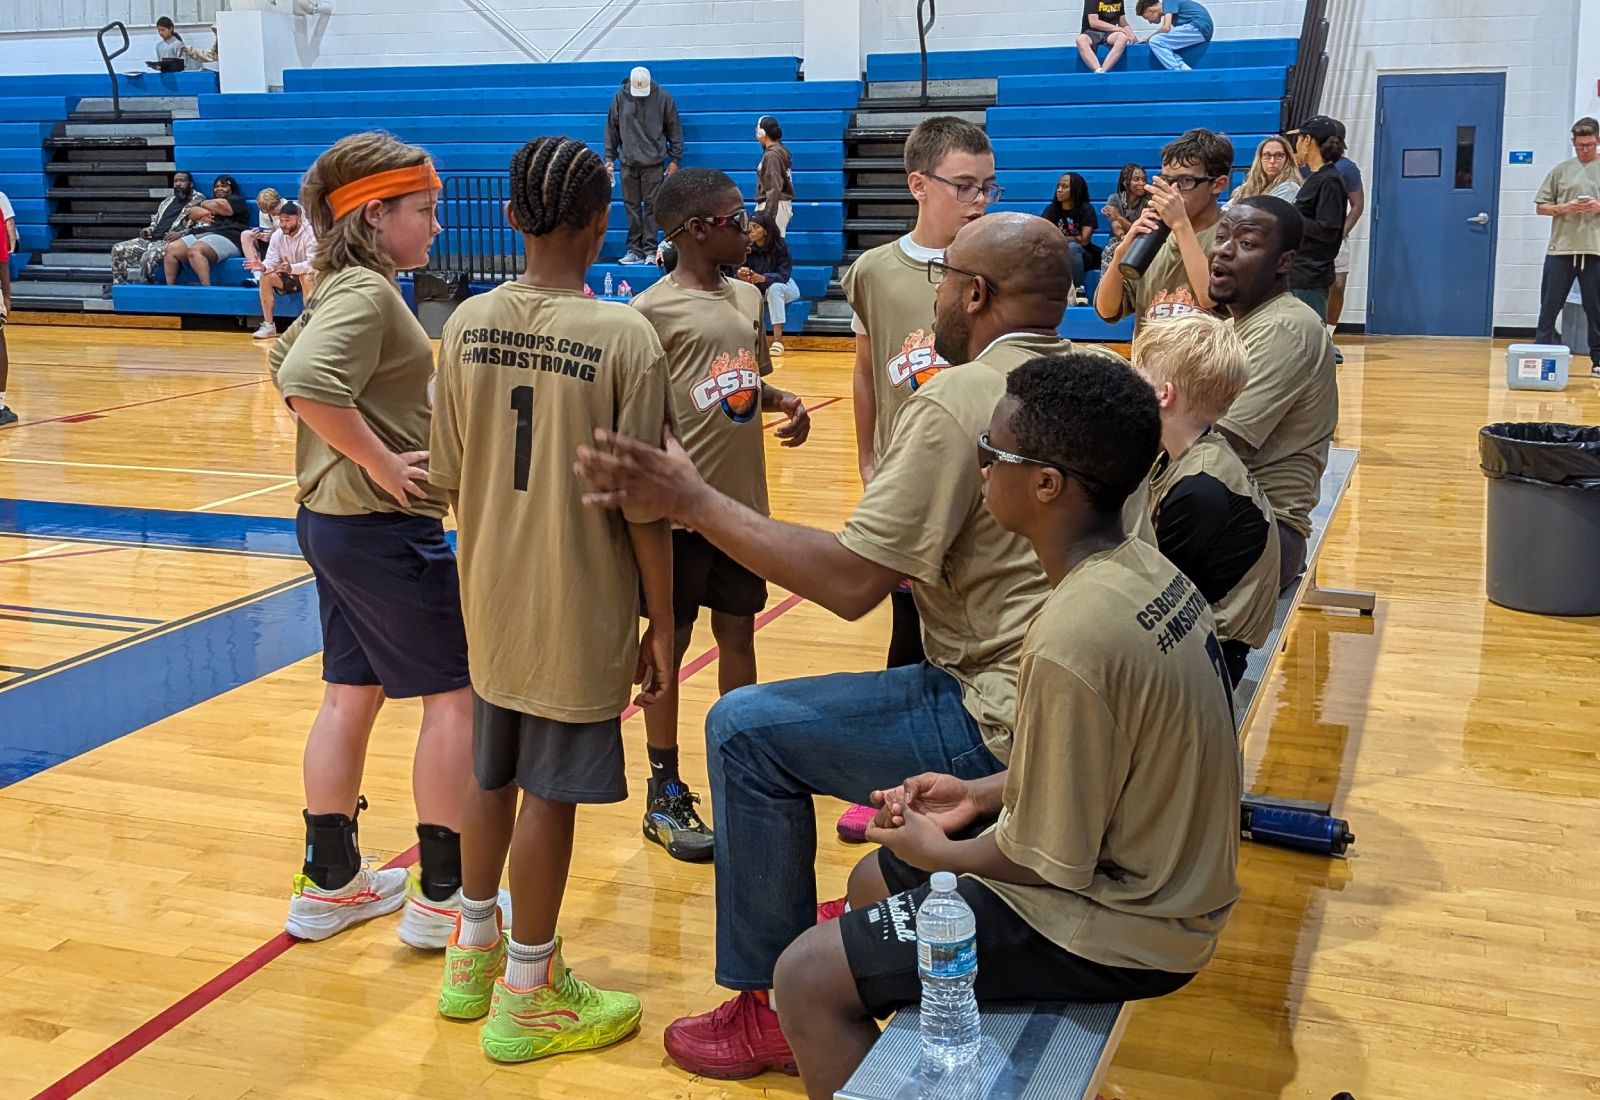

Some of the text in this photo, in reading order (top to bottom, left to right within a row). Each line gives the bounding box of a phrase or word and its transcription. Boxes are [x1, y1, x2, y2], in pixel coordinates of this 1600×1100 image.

[462, 328, 603, 363] CSBCHOOPS.COM
[462, 347, 597, 383] #MSDSTRONG
[510, 385, 534, 492] 1
